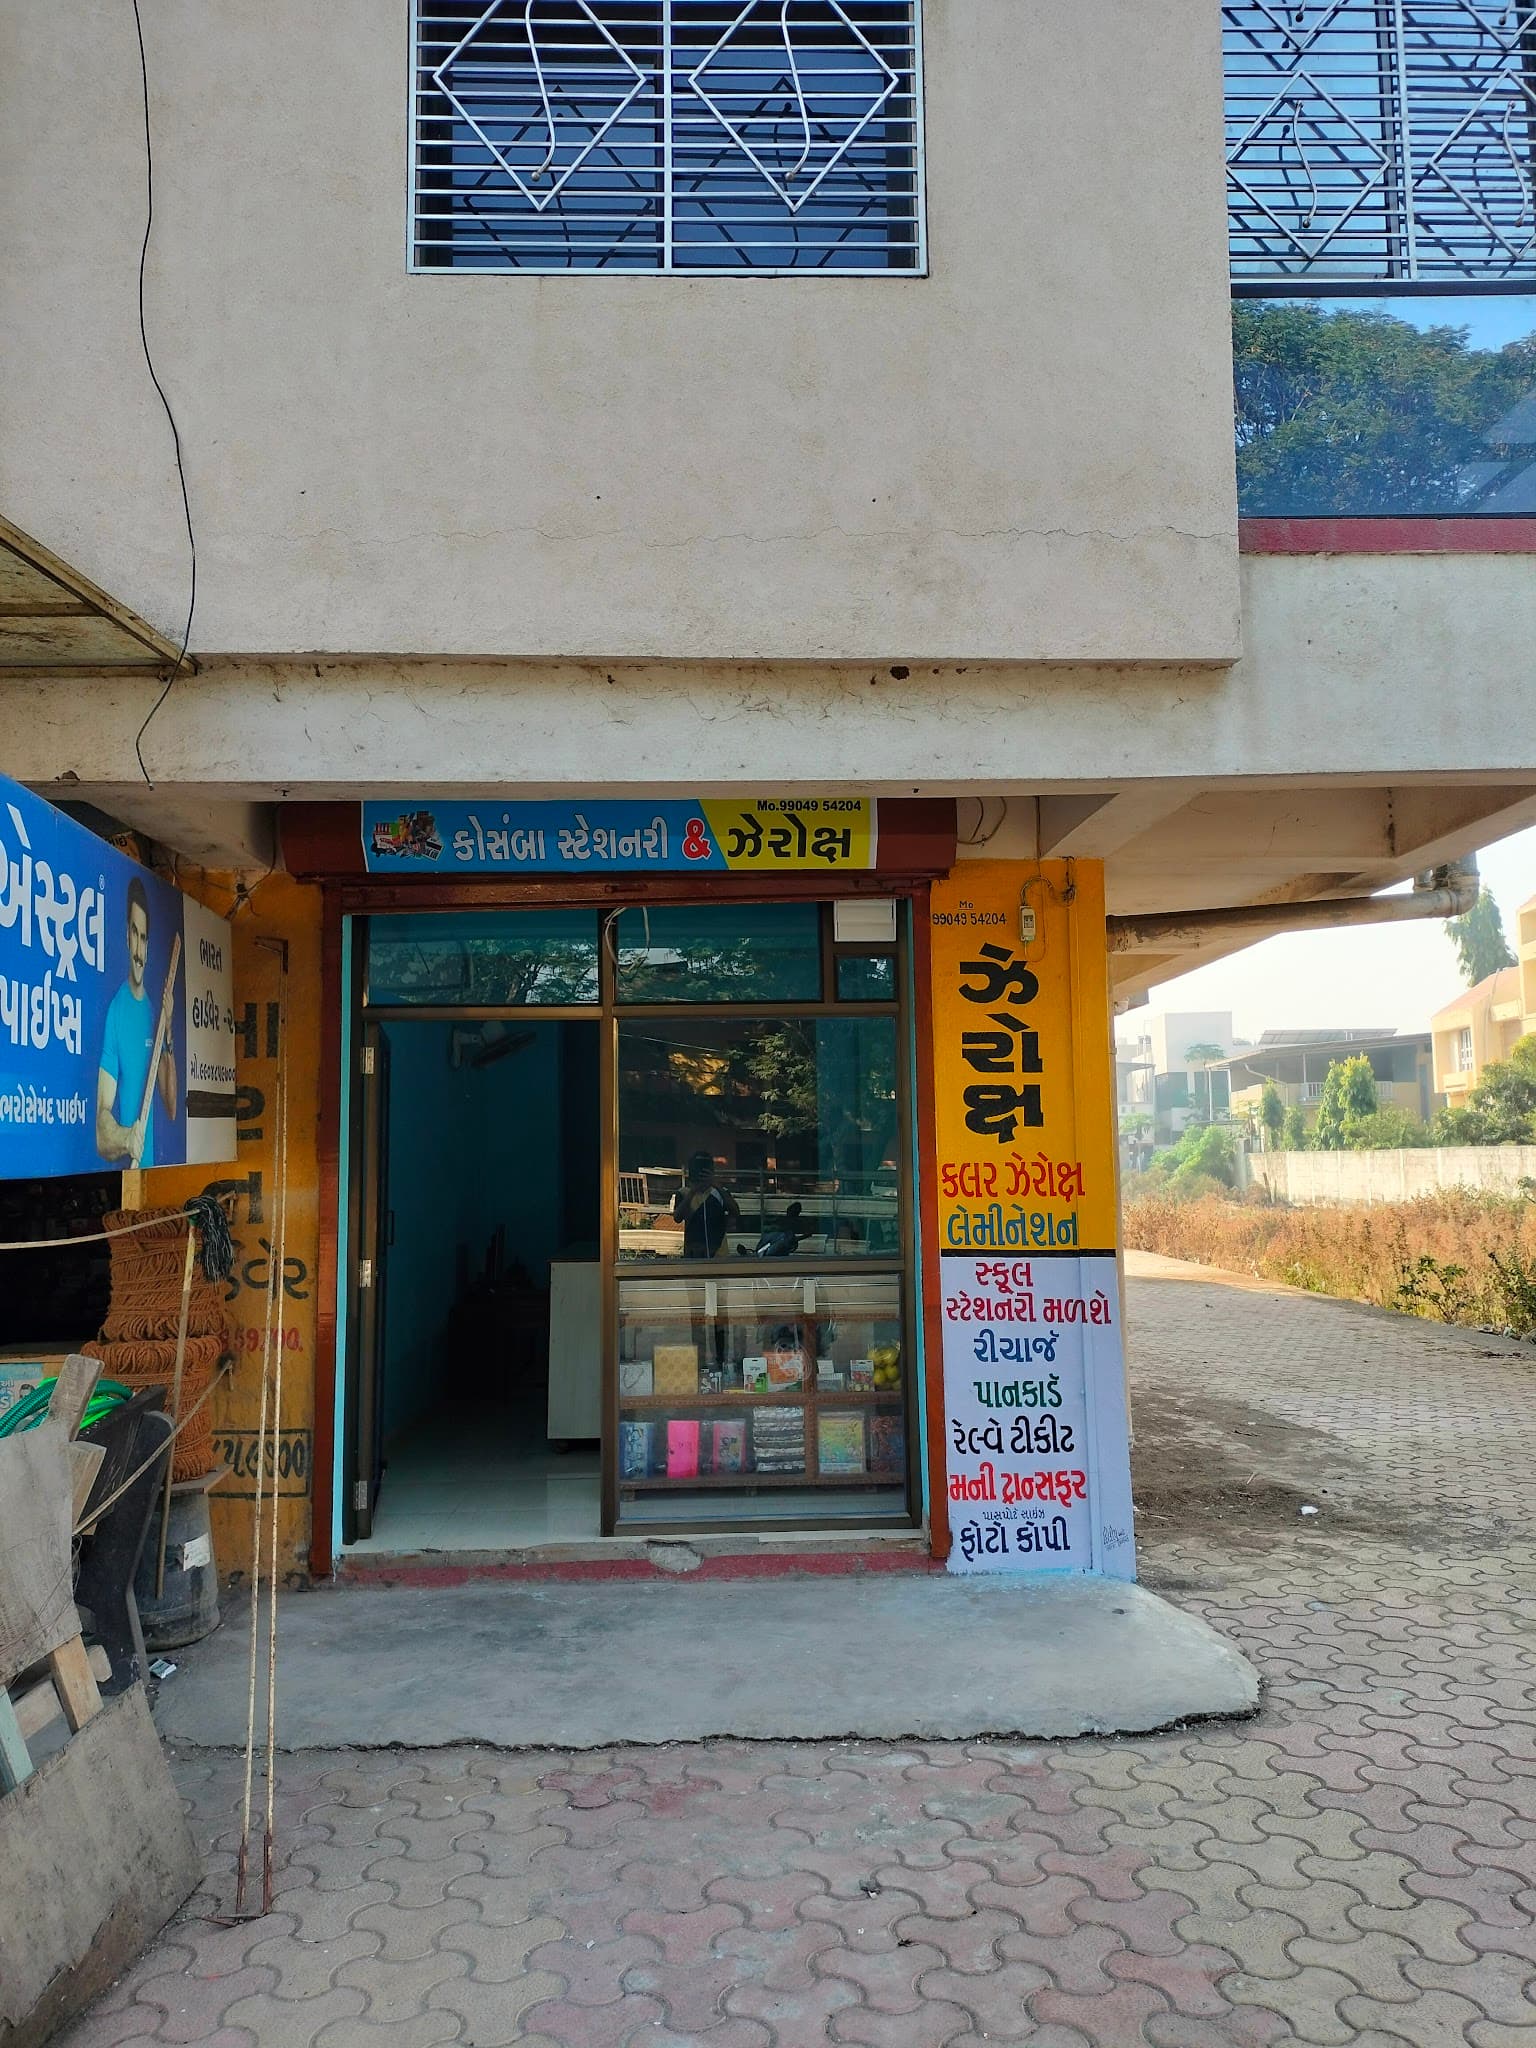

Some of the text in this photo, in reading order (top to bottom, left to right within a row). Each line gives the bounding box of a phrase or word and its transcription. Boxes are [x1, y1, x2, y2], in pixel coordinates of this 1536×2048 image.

[757, 800, 862, 811] Mo.99049 54204
[452, 813, 852, 863] કોસંબા સ્ટેશનરી & ઝેરોક્ષ
[932, 912, 1007, 925] 99049 54204
[959, 900, 974, 910] Mo
[200, 938, 222, 972] ભારત
[942, 1152, 1085, 1203] કલર ઝેરોક્ષ
[947, 1202, 1078, 1247] લેમીનેશન
[975, 1262, 1034, 1295] સ્કૂલ
[946, 1290, 1112, 1325] સ્ટેશનરી મળશે
[951, 1414, 1075, 1454] રેલ્વે ટીકીટ
[949, 1462, 1087, 1507] મની ટ્રાન્સફર
[960, 1519, 1008, 1562] ફોટો
[1016, 1515, 1071, 1553] કોપી
